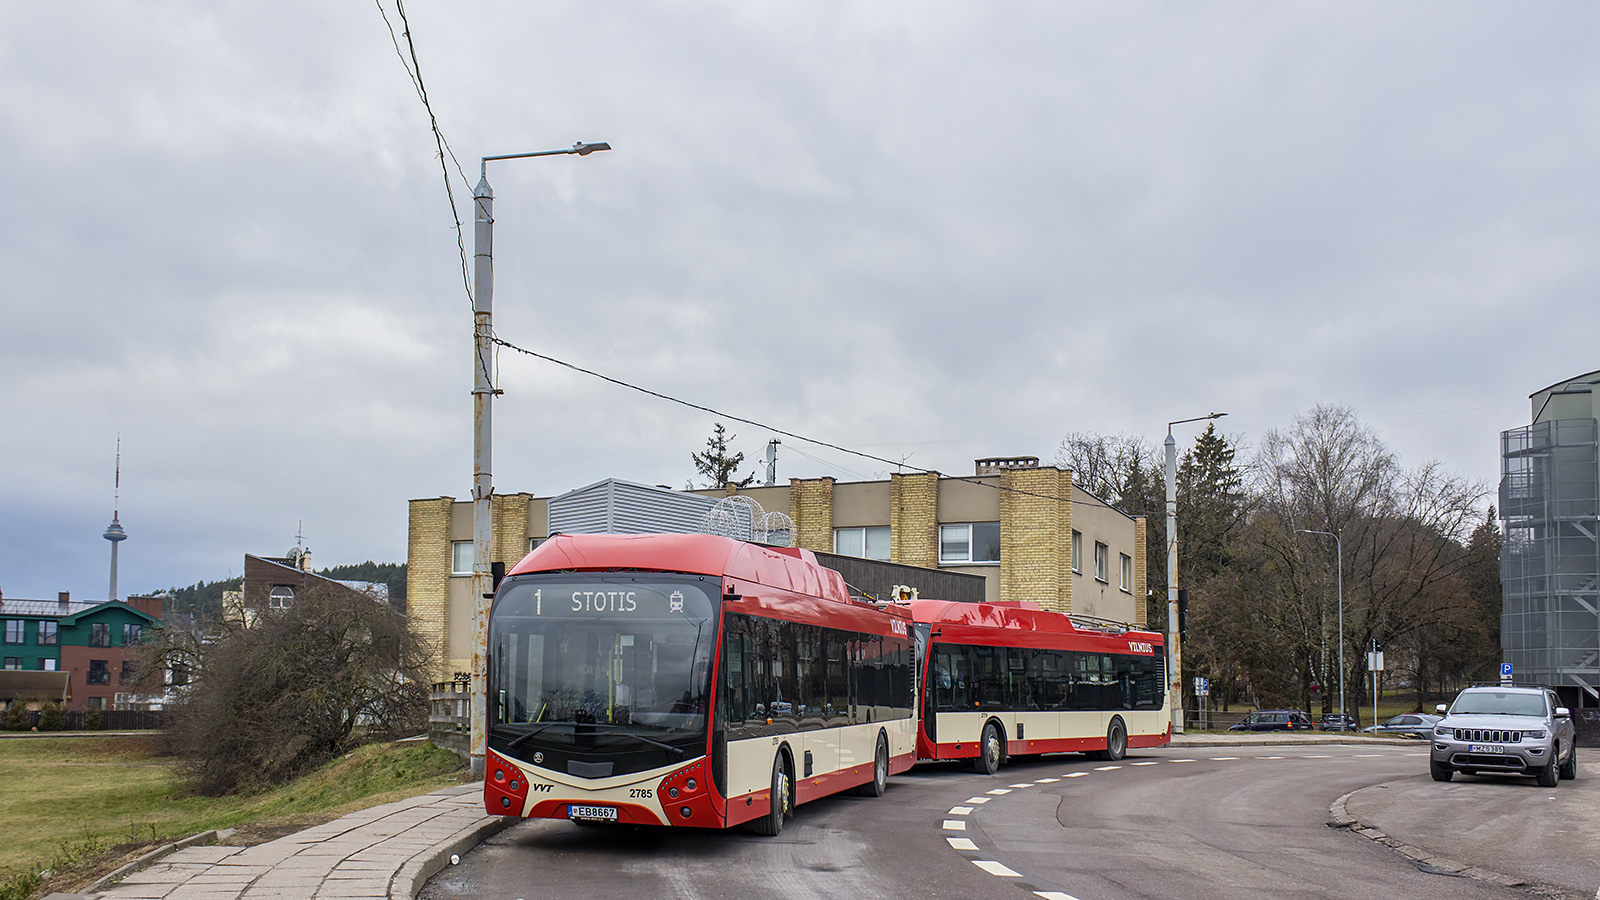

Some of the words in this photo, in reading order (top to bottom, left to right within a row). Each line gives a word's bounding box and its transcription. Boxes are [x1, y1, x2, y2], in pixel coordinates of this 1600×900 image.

[535, 589, 541, 615] 1
[571, 591, 637, 612] STOTIS
[1128, 641, 1152, 653] VILNIUS
[1504, 664, 1511, 673] P
[533, 783, 554, 793] VVT
[629, 788, 653, 798] 2785
[578, 807, 615, 818] EB8667
